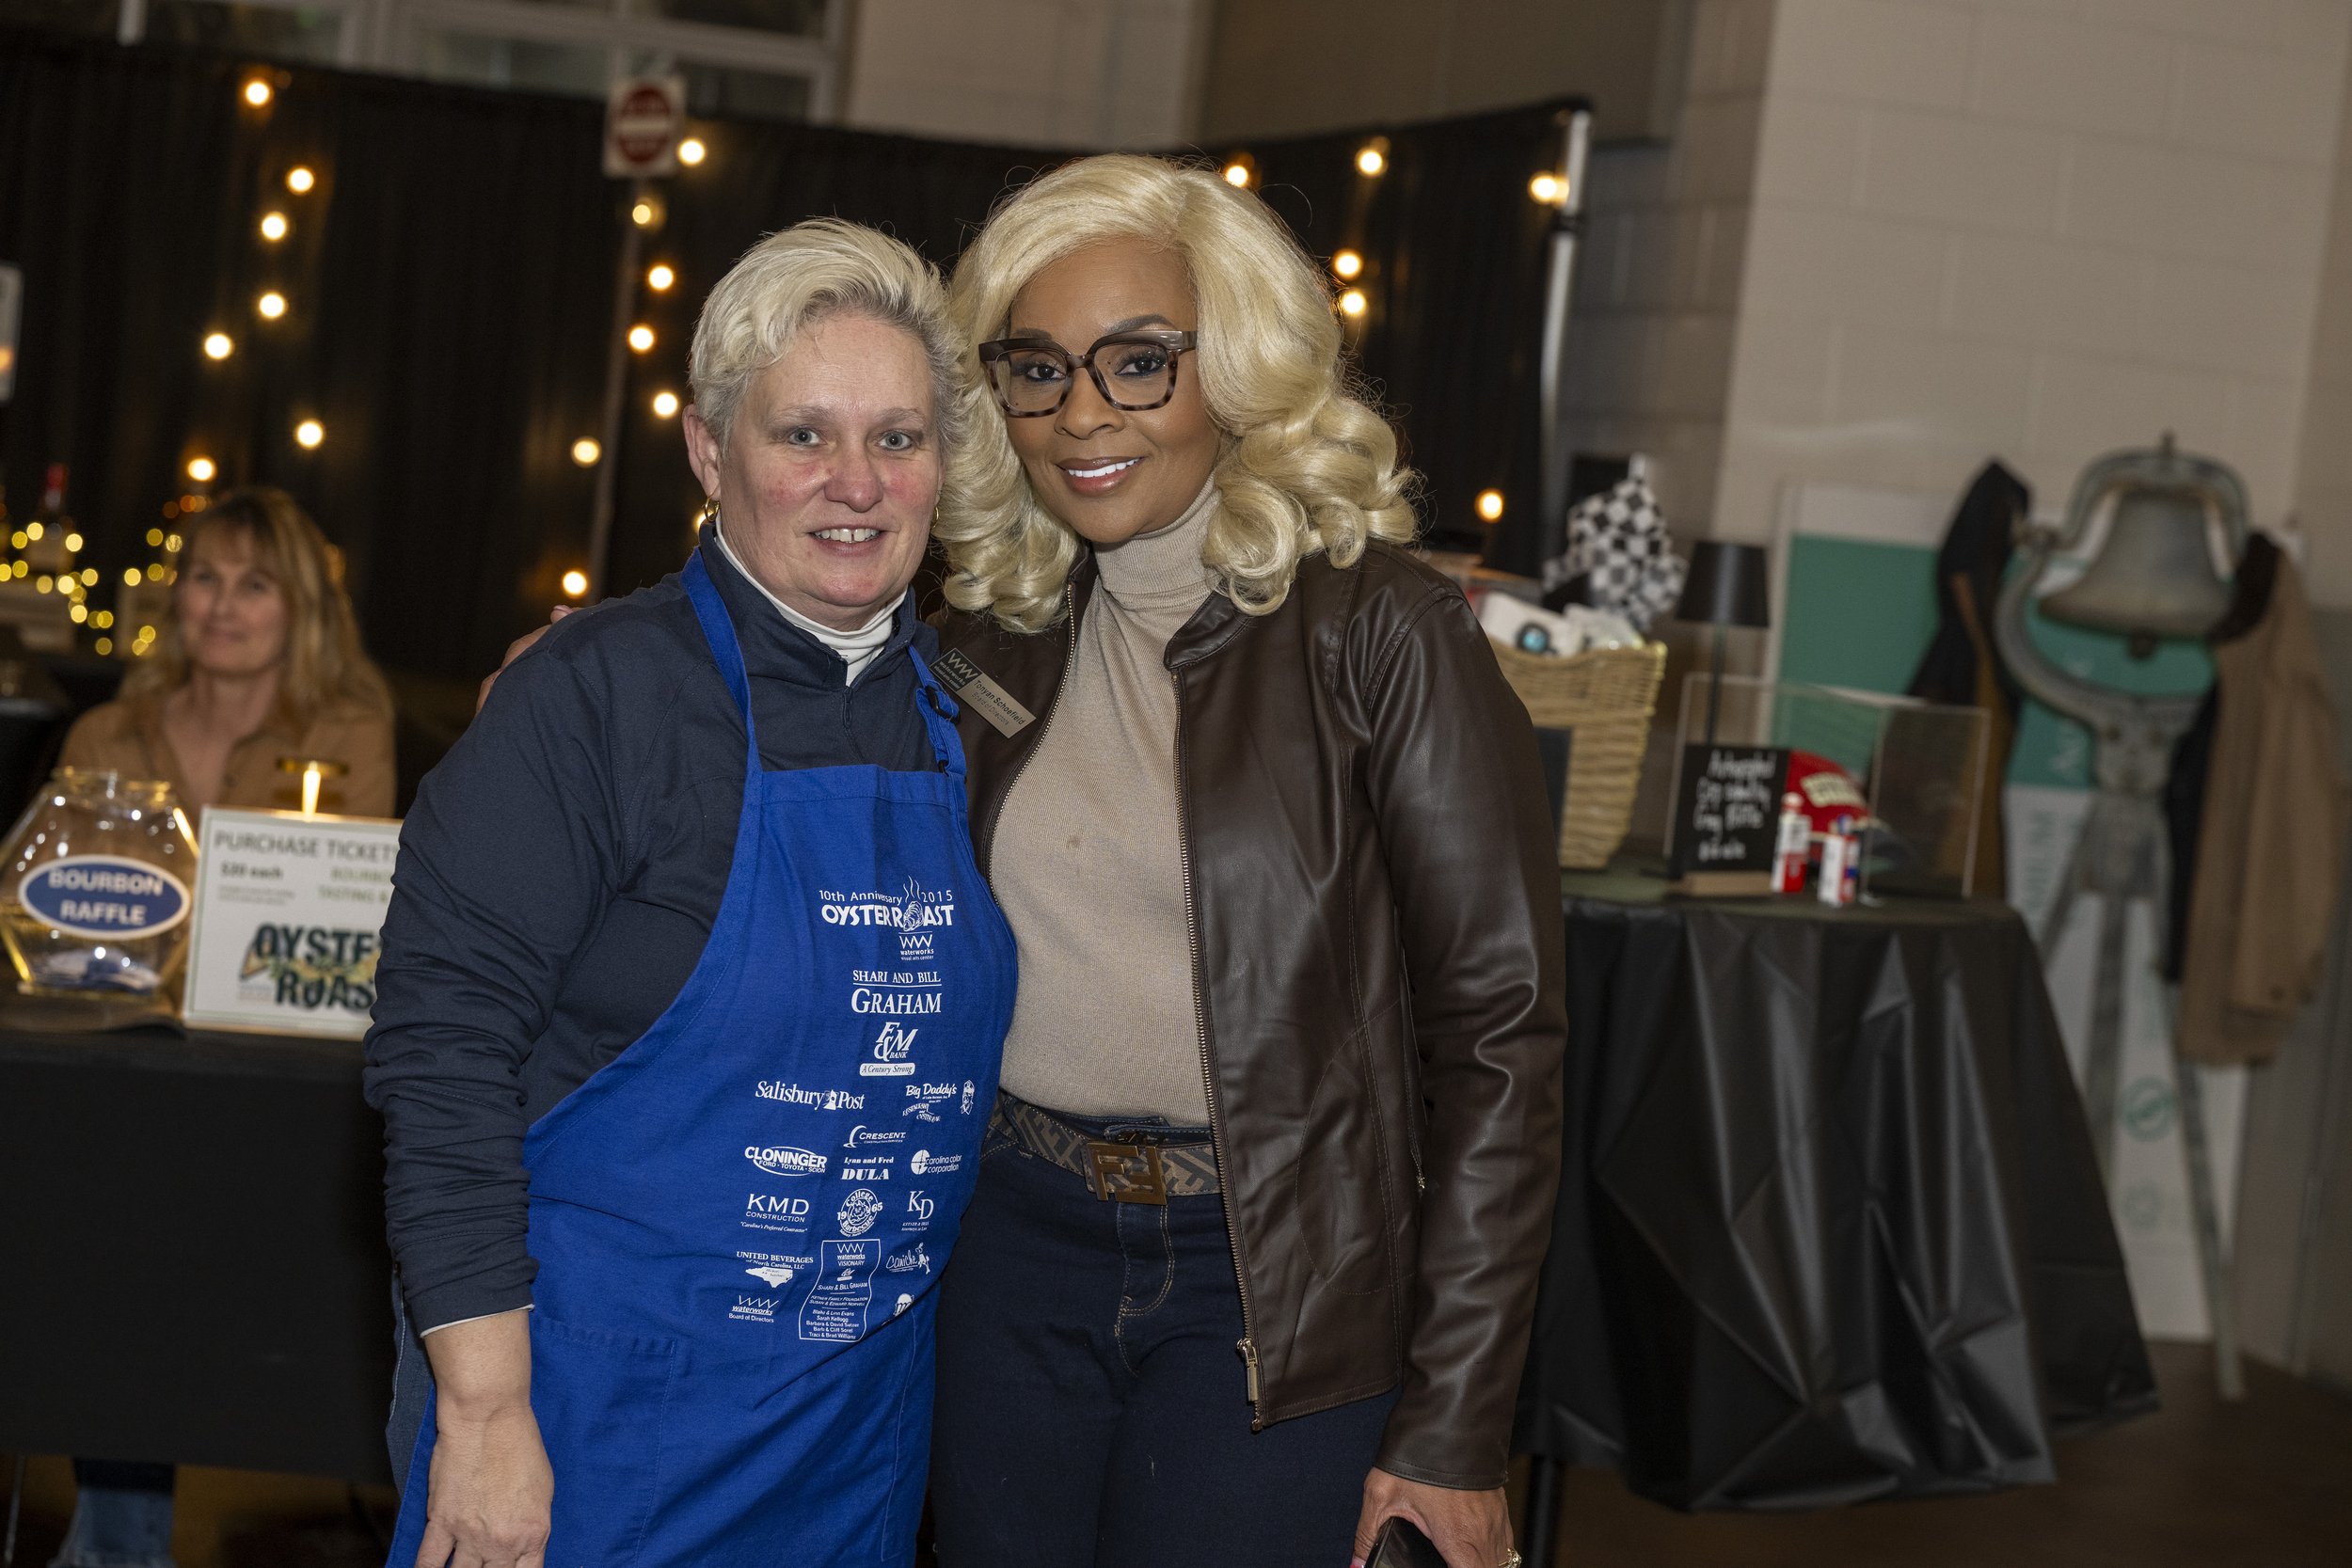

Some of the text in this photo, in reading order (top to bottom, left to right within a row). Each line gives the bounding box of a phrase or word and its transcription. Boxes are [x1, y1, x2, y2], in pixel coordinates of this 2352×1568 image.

[49, 867, 164, 896] BOURBON
[818, 890, 953, 906] 10th Anniversary 2015
[60, 900, 146, 927] RAFFLE
[255, 924, 378, 965] OYSTE
[852, 970, 942, 983] SHARI AND BILL
[276, 970, 374, 1010] ROAS
[851, 988, 942, 1014] GRAHAM
[867, 1064, 891, 1074] Century
[892, 1064, 913, 1075] Strong
[755, 1080, 865, 1110] Salisbury Post
[906, 1083, 957, 1099] Big Daddy's
[859, 1132, 906, 1140] CRESCENT
[744, 1146, 827, 1168] CLONINGER
[925, 1155, 949, 1165] carolina
[840, 1168, 889, 1180] DULA
[927, 1164, 960, 1175] corporation
[747, 1193, 810, 1215] KMD
[846, 1190, 874, 1207] College
[745, 1211, 805, 1223] CONSTRUCTION
[737, 1251, 814, 1263] UNITED BEVERAGES
[731, 1305, 773, 1316] waterworks
[751, 1315, 774, 1323] Directors
